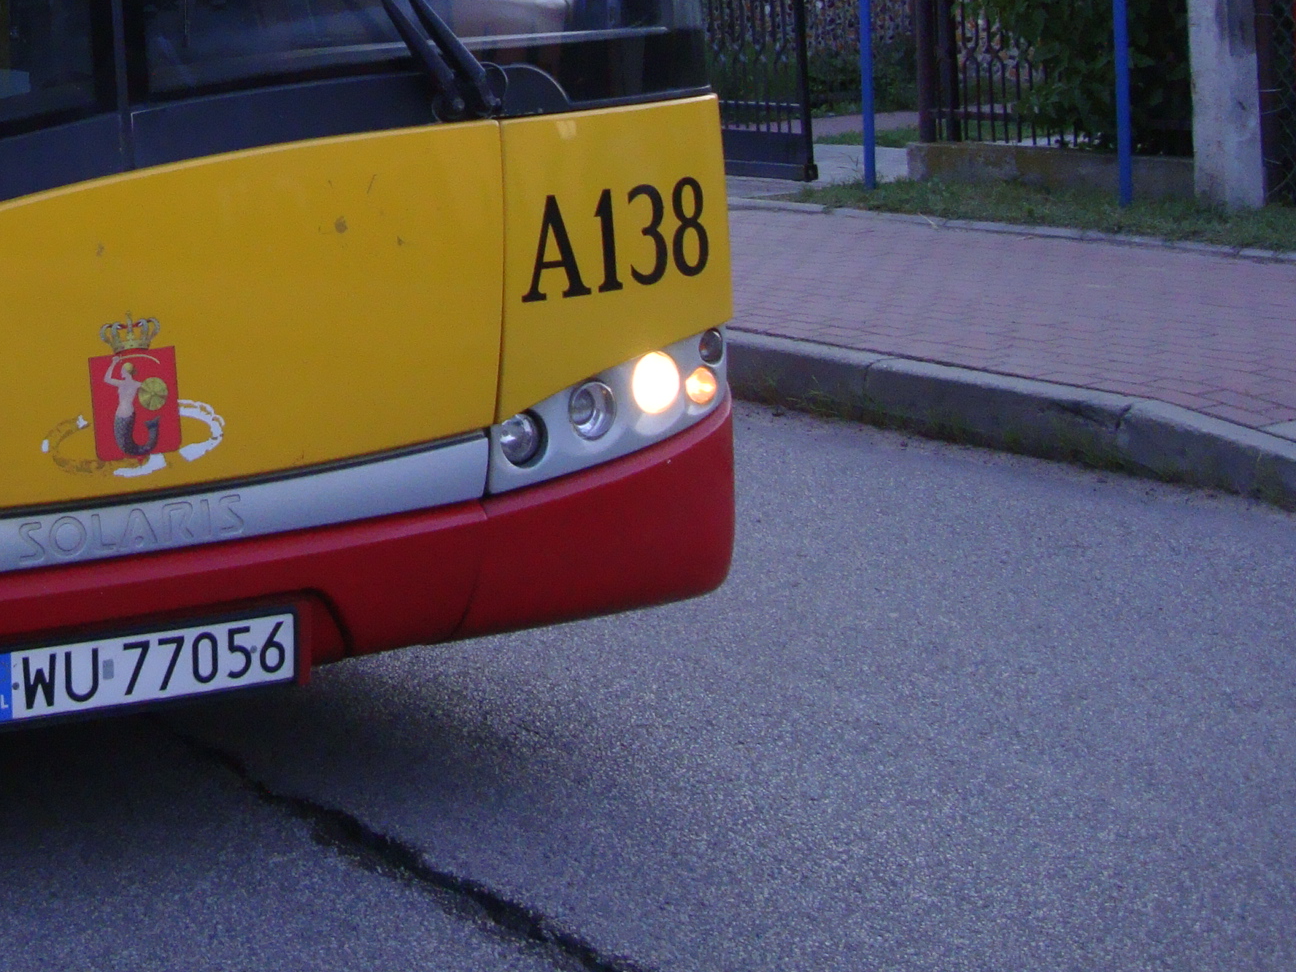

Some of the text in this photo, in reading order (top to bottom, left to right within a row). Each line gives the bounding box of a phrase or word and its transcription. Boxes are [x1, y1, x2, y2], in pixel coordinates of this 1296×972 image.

[521, 176, 709, 303] A138
[18, 493, 245, 565] SOLARIS
[21, 620, 286, 711] WU 77056
